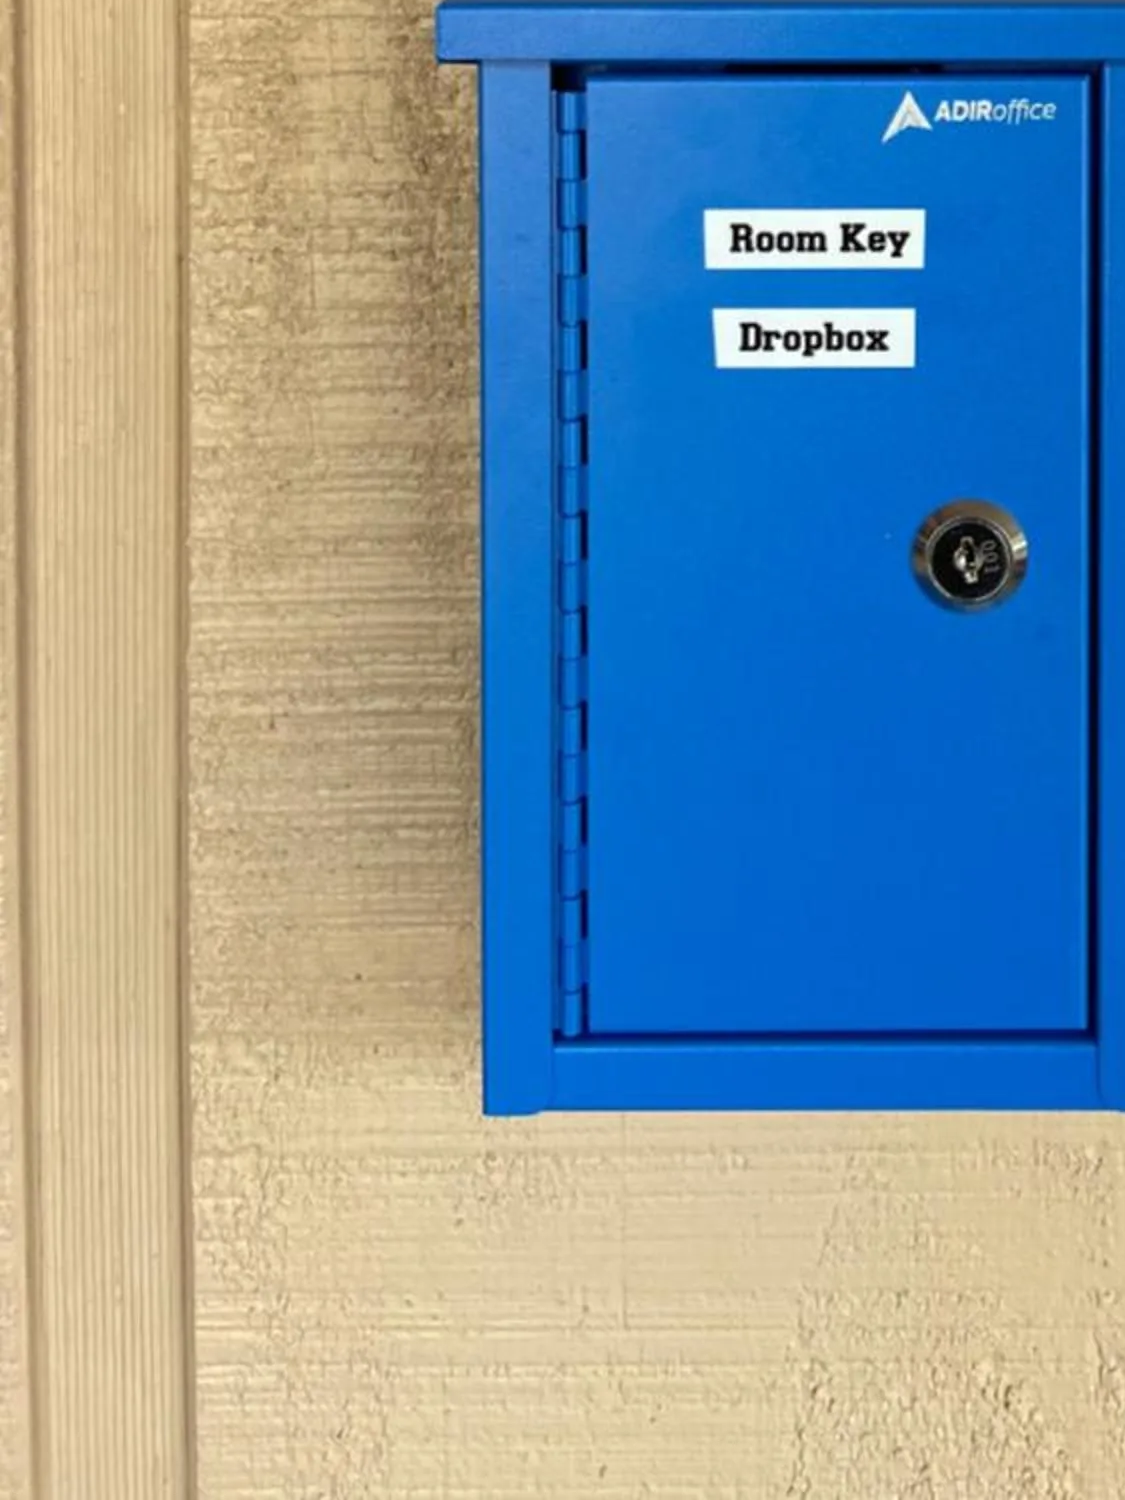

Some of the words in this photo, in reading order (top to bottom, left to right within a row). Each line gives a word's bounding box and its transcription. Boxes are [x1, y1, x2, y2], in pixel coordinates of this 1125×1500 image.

[934, 98, 1057, 125] ADIRoffice
[729, 223, 828, 253] Room
[839, 223, 910, 258] Key
[738, 322, 890, 357] Dropbox
